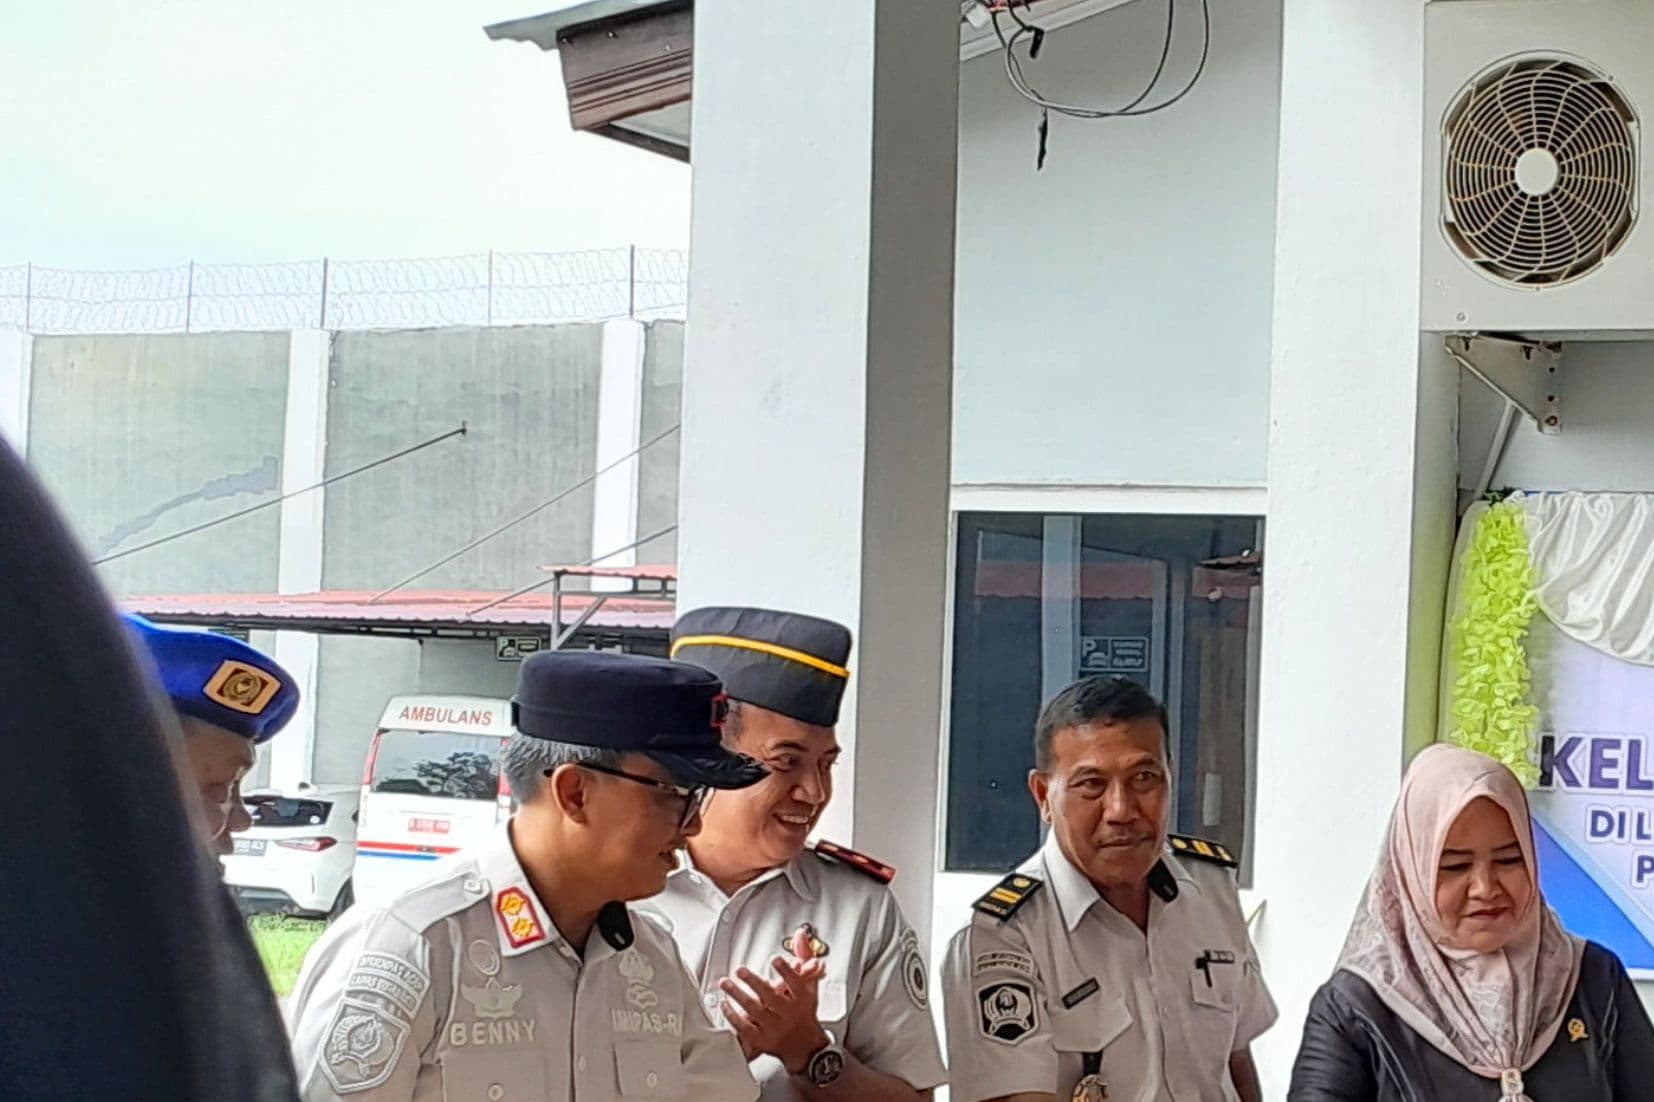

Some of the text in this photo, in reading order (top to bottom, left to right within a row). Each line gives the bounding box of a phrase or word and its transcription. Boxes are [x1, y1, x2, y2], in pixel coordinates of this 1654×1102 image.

[399, 706, 493, 726] AMBULANS
[1590, 809, 1626, 839] DI
[451, 1019, 536, 1047] BENNY
